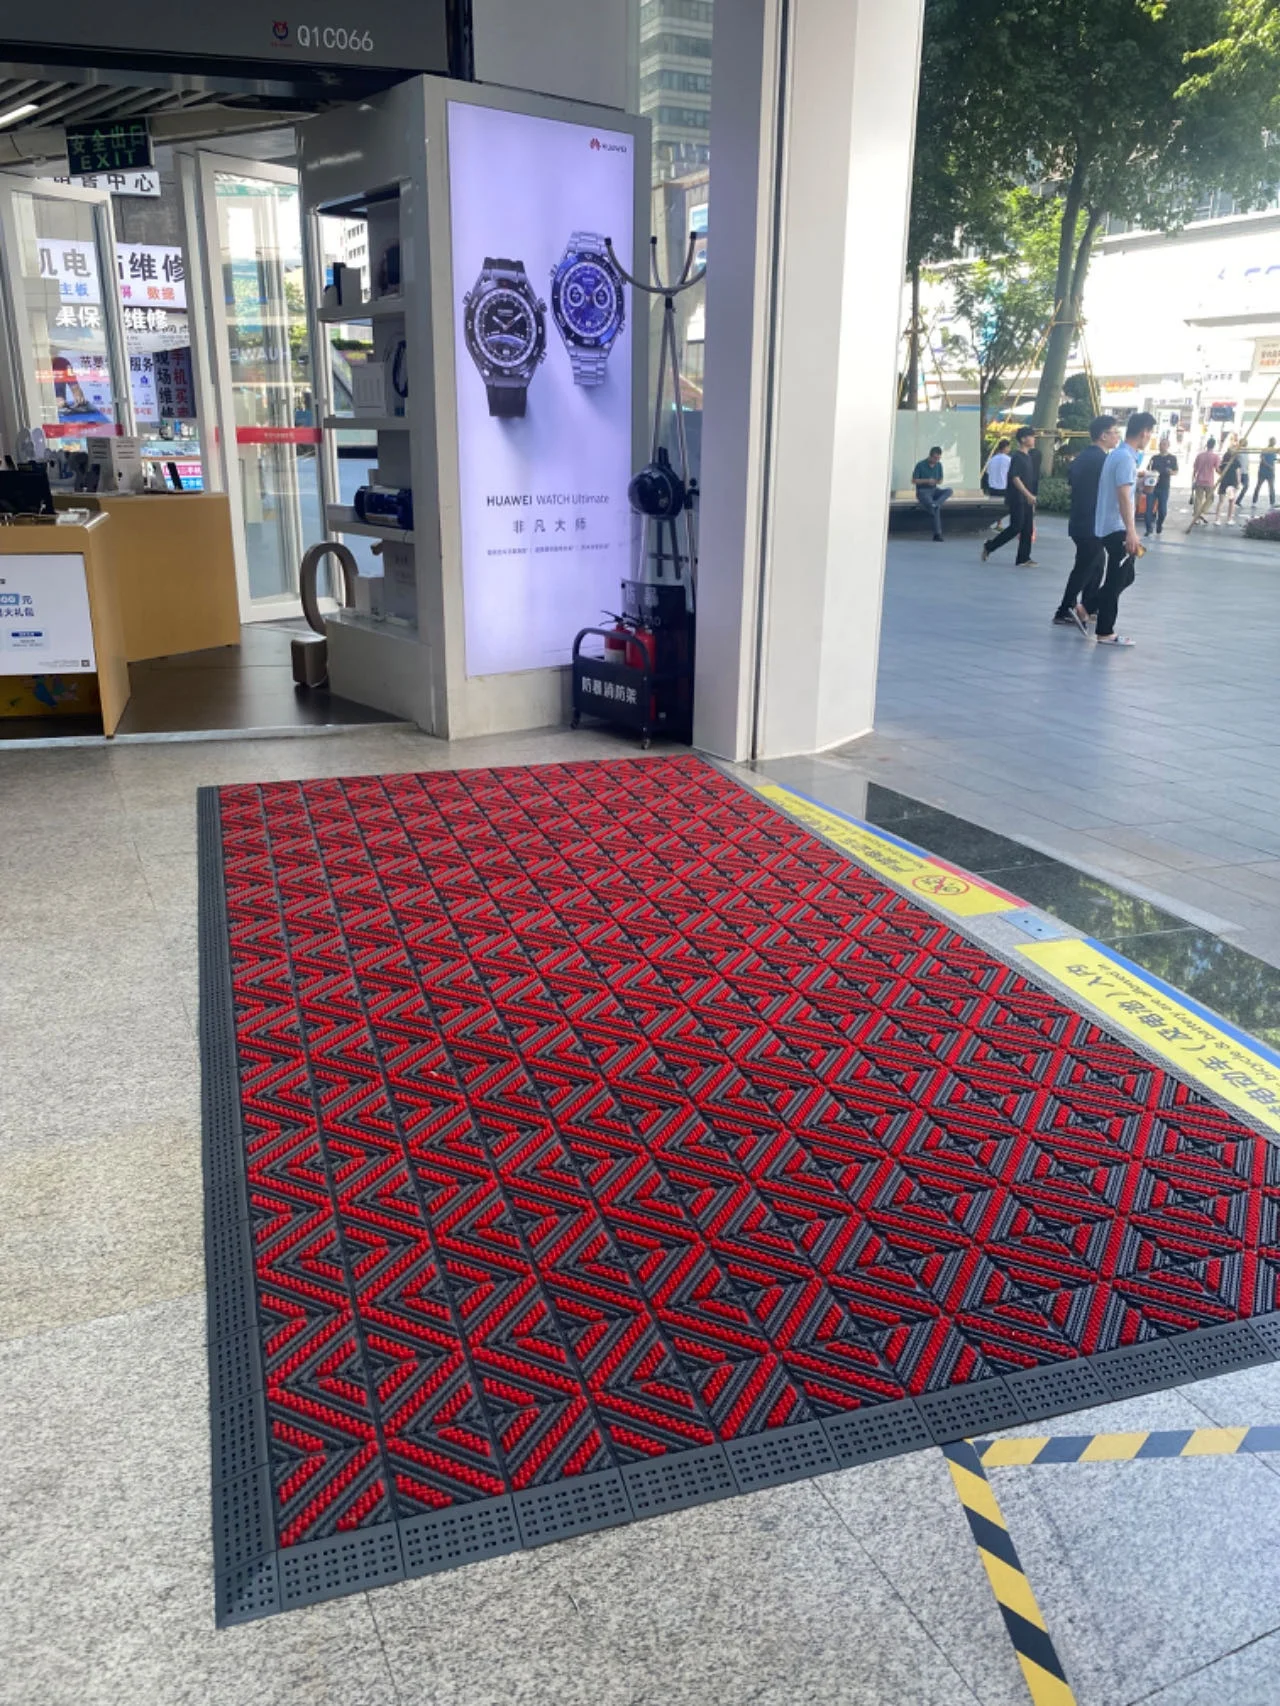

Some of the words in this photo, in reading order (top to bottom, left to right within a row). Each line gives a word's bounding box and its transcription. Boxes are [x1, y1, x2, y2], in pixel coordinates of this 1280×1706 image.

[297, 25, 374, 52] Q1C066
[72, 126, 144, 154] 安全出口
[80, 149, 136, 170] EXIT
[486, 495, 533, 507] HUAWEI
[535, 494, 571, 505] WATCH
[571, 493, 610, 505] Ultimate
[513, 517, 587, 534] 非凡大师
[1108, 969, 1153, 999] allowed
[1151, 995, 1173, 1012] are
[1169, 1010, 1217, 1041] battery
[1229, 1050, 1277, 1082] bicycle
